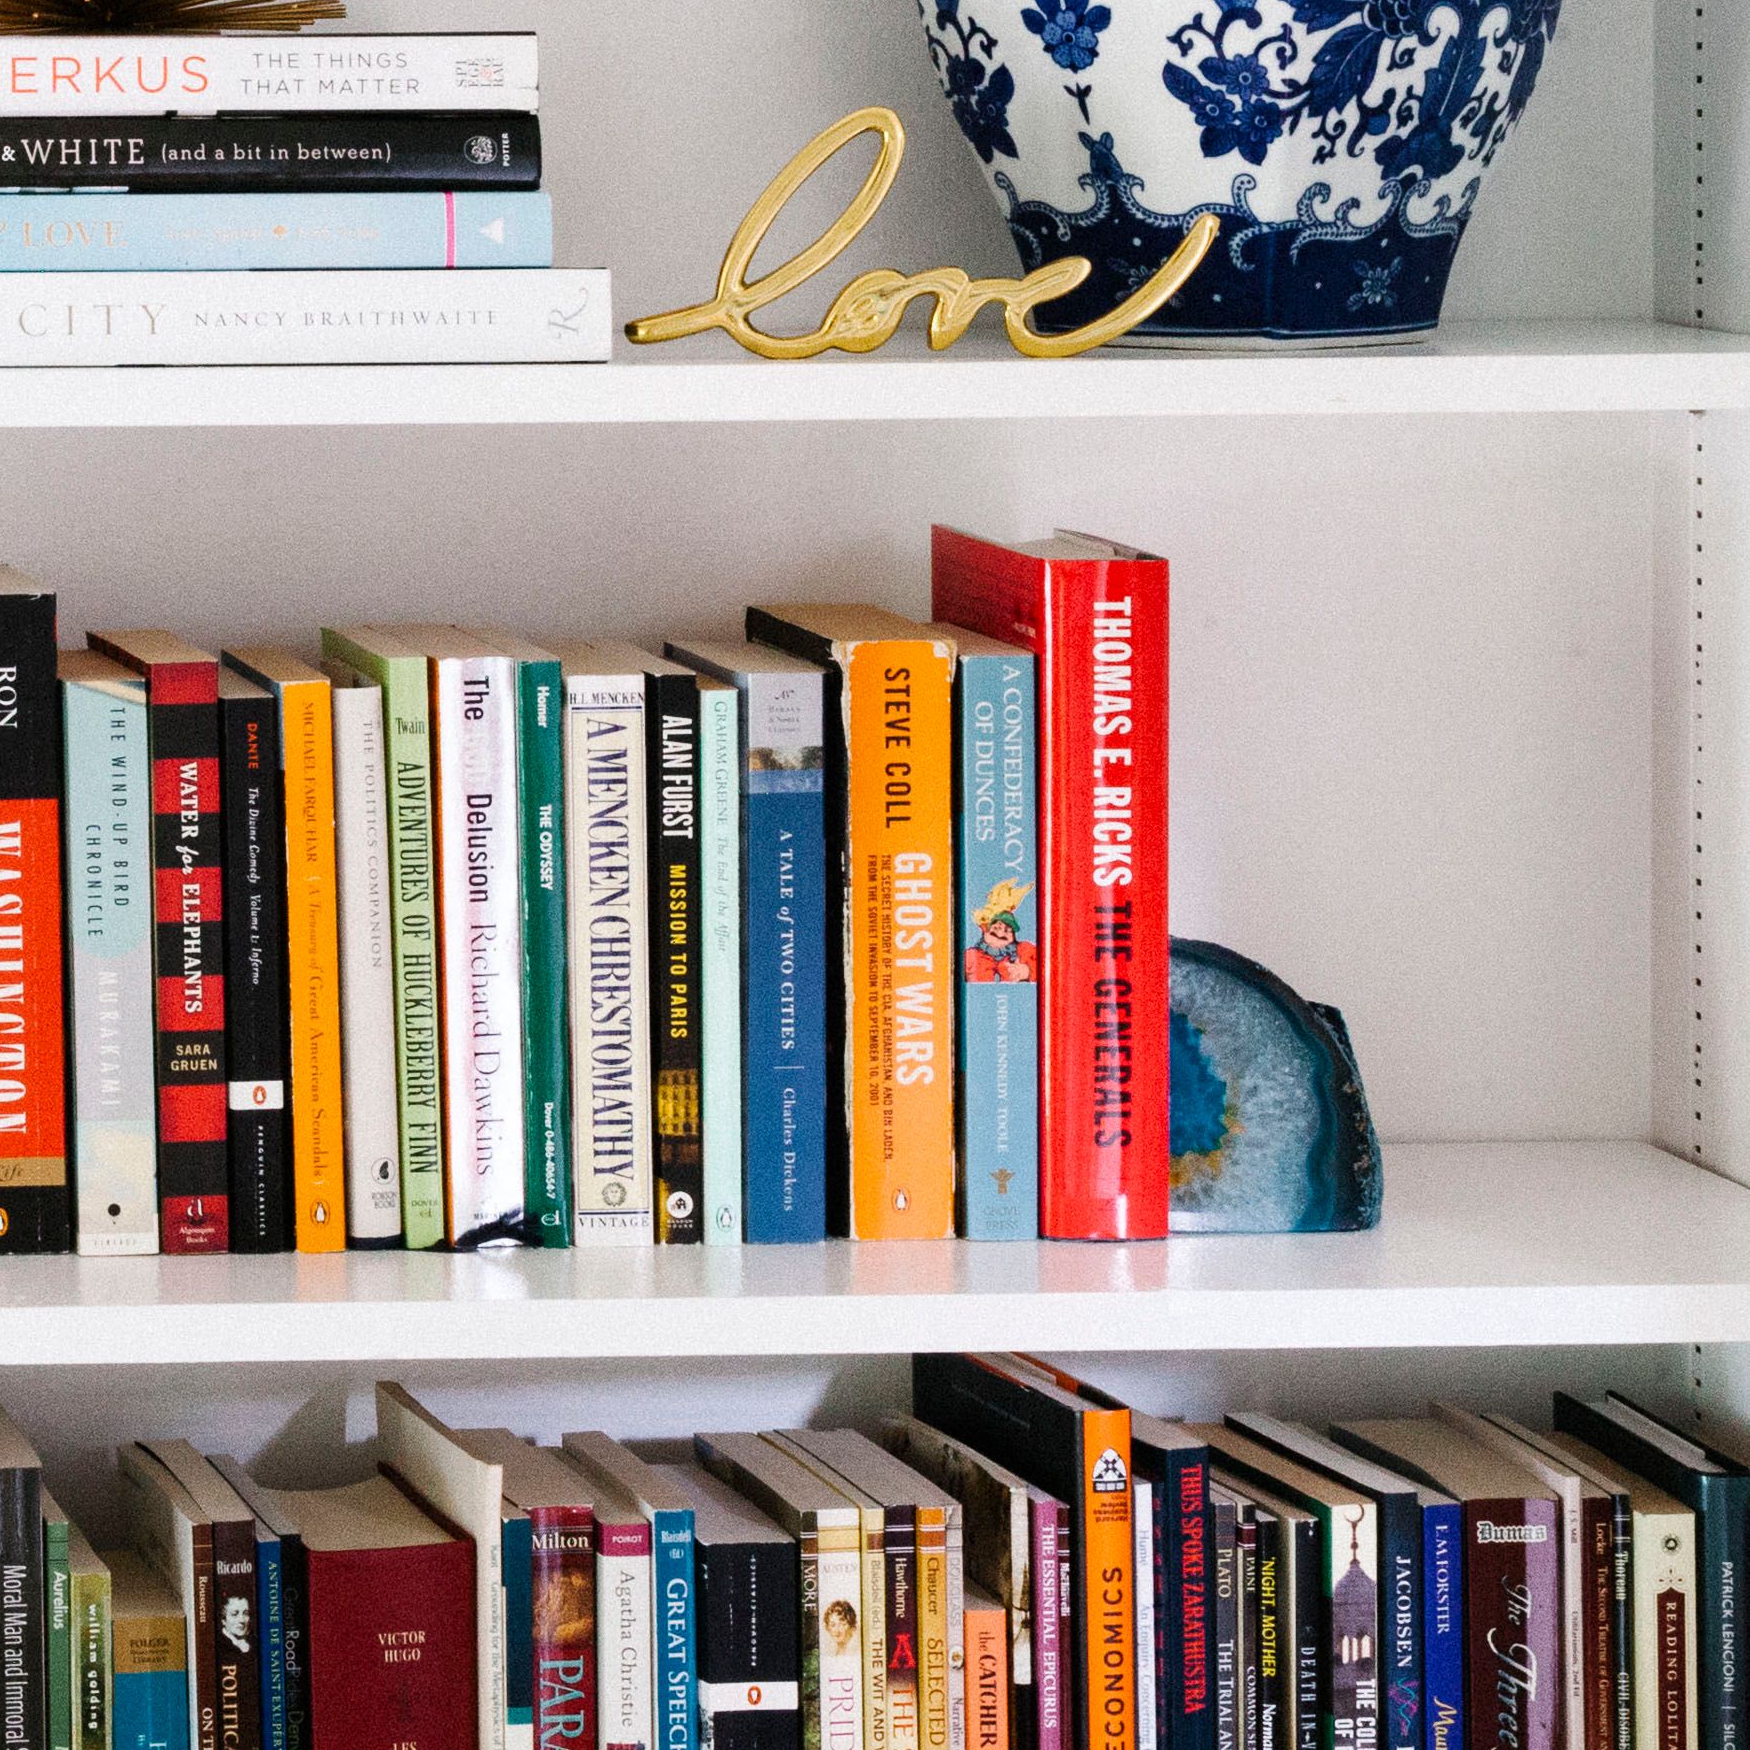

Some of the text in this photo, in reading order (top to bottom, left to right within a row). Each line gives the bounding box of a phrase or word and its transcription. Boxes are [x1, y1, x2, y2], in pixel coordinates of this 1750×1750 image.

[241, 79, 420, 94] THAT MATTER
[252, 53, 408, 68] THE THINGS
[161, 143, 205, 163] (and
[215, 148, 225, 159] a
[234, 143, 262, 159] bit
[270, 144, 288, 159] in
[298, 143, 391, 161] between)
[502, 133, 510, 167] POTTER
[22, 220, 128, 247] LOVE
[624, 106, 1220, 359] love
[195, 313, 286, 327] NANCY
[305, 311, 496, 326] BRAITHWAITE
[246, 723, 259, 770] DANTE
[395, 717, 425, 735] Twain
[884, 667, 912, 829] STEVE COLL
[975, 702, 995, 841] OF DUNCES
[1003, 665, 1026, 873] A CONFEDERACY
[110, 707, 129, 907] THE WIND-UP BIRD
[537, 686, 554, 891] Homer THE ODYSSEY
[86, 824, 103, 937] CHRONICLE
[175, 762, 203, 1014] WATER for ELEPHANTS
[463, 675, 504, 1176] The Delusion Richard Dawkins
[662, 715, 693, 1039] ALAN FURST MISSION TO PARIS
[1093, 596, 1133, 1149] THOMAS E. RICKS THE GENERALS
[397, 761, 438, 1174] ADVENTURES OF HUCKLEBERRY FINN
[588, 718, 634, 1180] A MENCKEN CHRESTOMATHY
[894, 852, 934, 1086] GHOST WARS
[171, 1060, 217, 1071] GRUEN
[176, 1044, 210, 1056] SARA
[774, 830, 797, 1212] A TALE of TWO CITIES Charles Dickens
[217, 1560, 252, 1575] Ricardo
[532, 1535, 589, 1549] Milton
[3, 1565, 30, 1744] Moral Man and Immoral
[53, 1572, 68, 1629] Aurelius
[378, 1632, 426, 1646] VICTOR
[384, 1649, 421, 1662] HUGO
[615, 1571, 638, 1727] Agatha Christie
[667, 1578, 688, 1663] GREAT
[1395, 1556, 1413, 1668] JACOBSEN
[1666, 1602, 1677, 1681] READING
[1722, 1561, 1734, 1692] PATRICK LENCIONI
[88, 1604, 100, 1729] william golding
